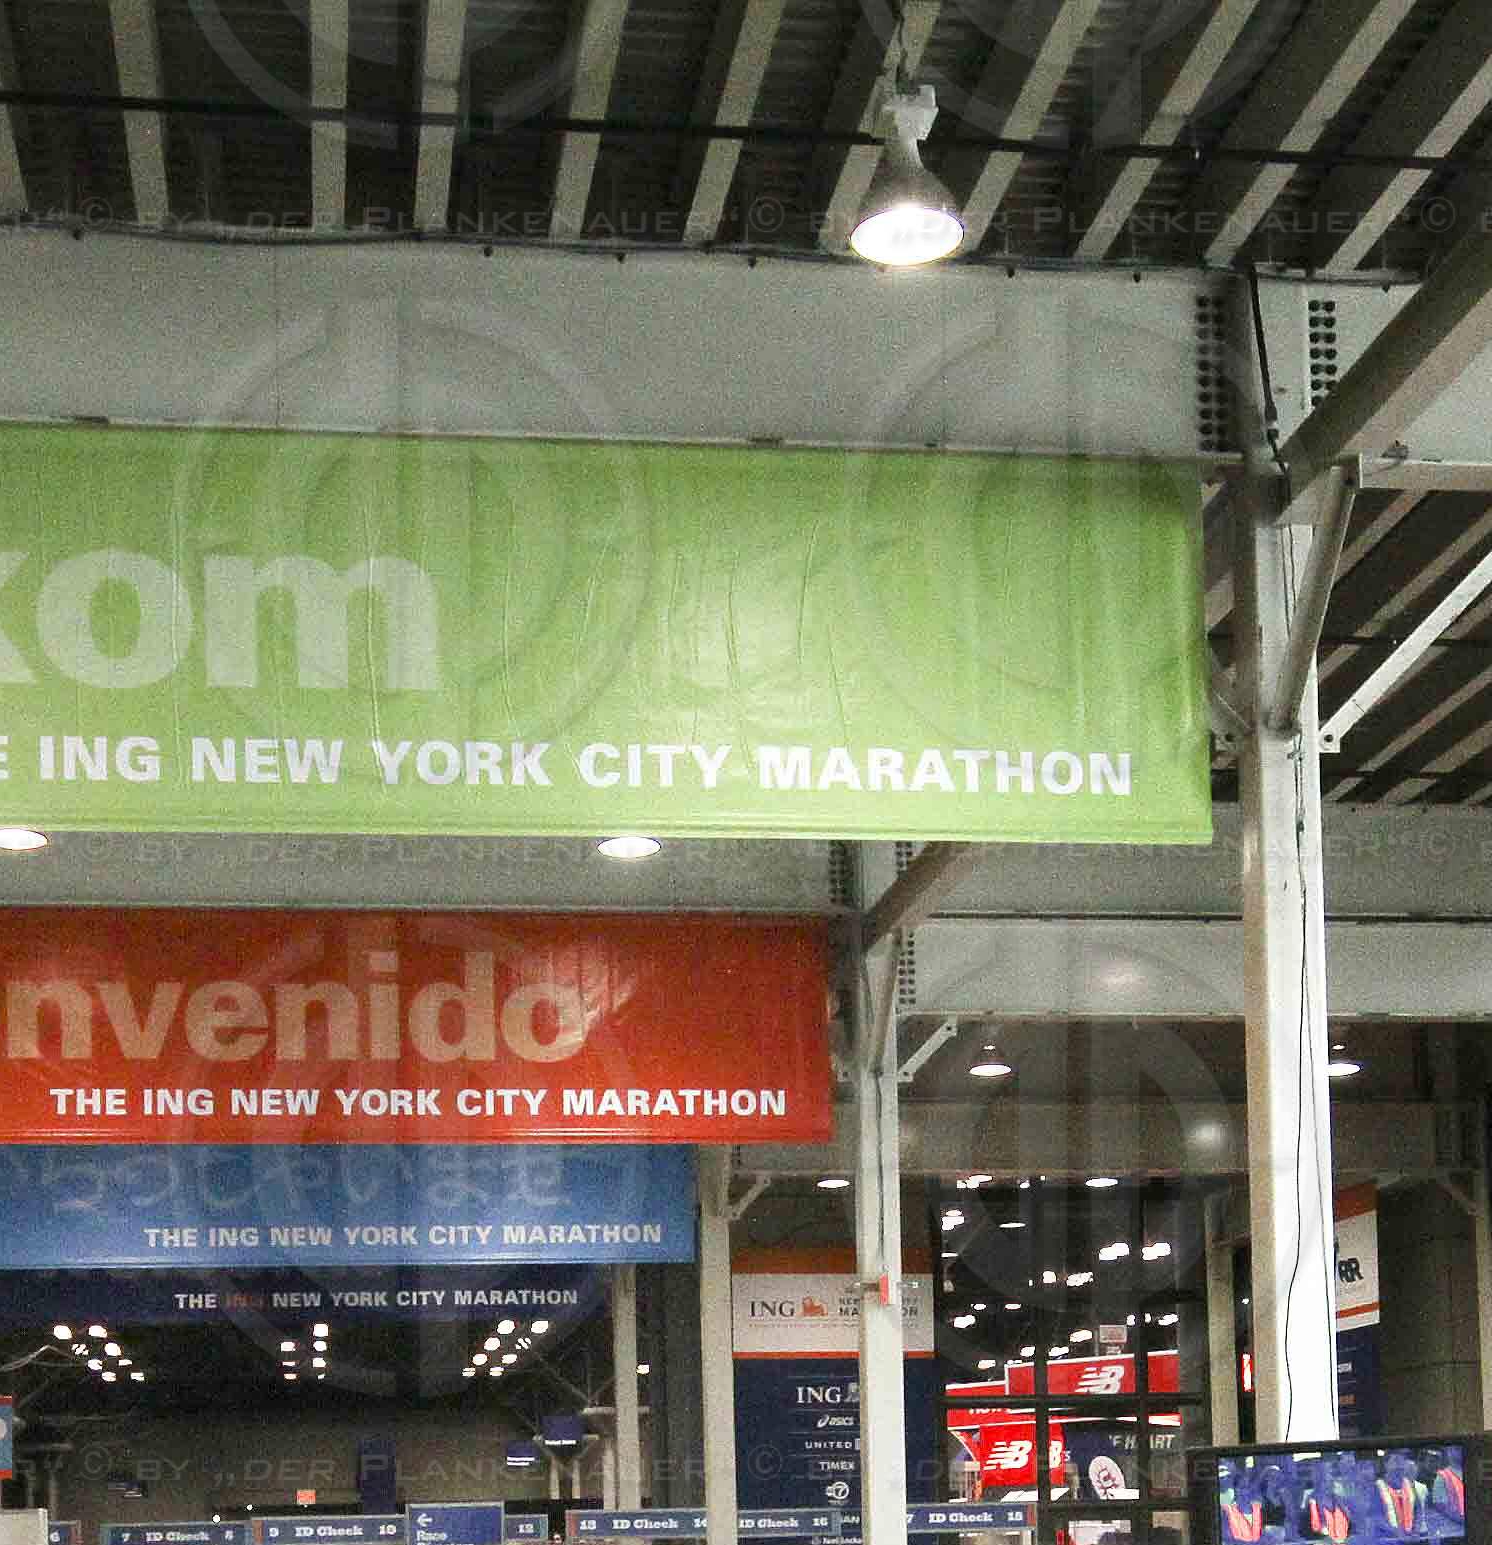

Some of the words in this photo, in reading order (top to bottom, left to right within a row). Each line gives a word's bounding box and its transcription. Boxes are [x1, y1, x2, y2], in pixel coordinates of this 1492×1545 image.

[41, 734, 161, 784] ING
[192, 737, 343, 785] NEW
[372, 738, 552, 788] YORK
[578, 742, 733, 790] CITY
[757, 745, 1133, 797] MARATHON
[50, 1088, 128, 1117] THE
[143, 1088, 215, 1117] ING
[230, 1088, 319, 1117] NEW
[334, 1088, 442, 1117] YORK
[457, 1088, 550, 1117] CITY
[562, 1088, 787, 1117] MARATHON
[144, 1228, 198, 1249] THE
[209, 1227, 260, 1248] ING
[269, 1226, 332, 1248] NEW
[344, 1226, 418, 1247] YORK
[428, 1225, 493, 1246] CITY
[501, 1224, 662, 1245] MARATHON
[175, 1293, 218, 1309] THE
[272, 1292, 321, 1308] NEW
[331, 1291, 389, 1308] YORK
[395, 1290, 447, 1306] CITY
[454, 1288, 579, 1306] MARATHON
[748, 1300, 796, 1318] ING
[795, 1386, 841, 1404] ING
[804, 1441, 853, 1450] UNITED
[819, 1461, 855, 1471] TIMEX
[612, 1519, 632, 1531] ID
[633, 1517, 680, 1530] Check
[738, 1518, 756, 1529] ID
[757, 1517, 800, 1529] Check
[928, 1512, 947, 1523] ID
[948, 1511, 994, 1523] Check
[145, 1531, 163, 1542] ID
[295, 1525, 315, 1538] ID
[316, 1524, 365, 1537] Check
[416, 1529, 448, 1542] Race
